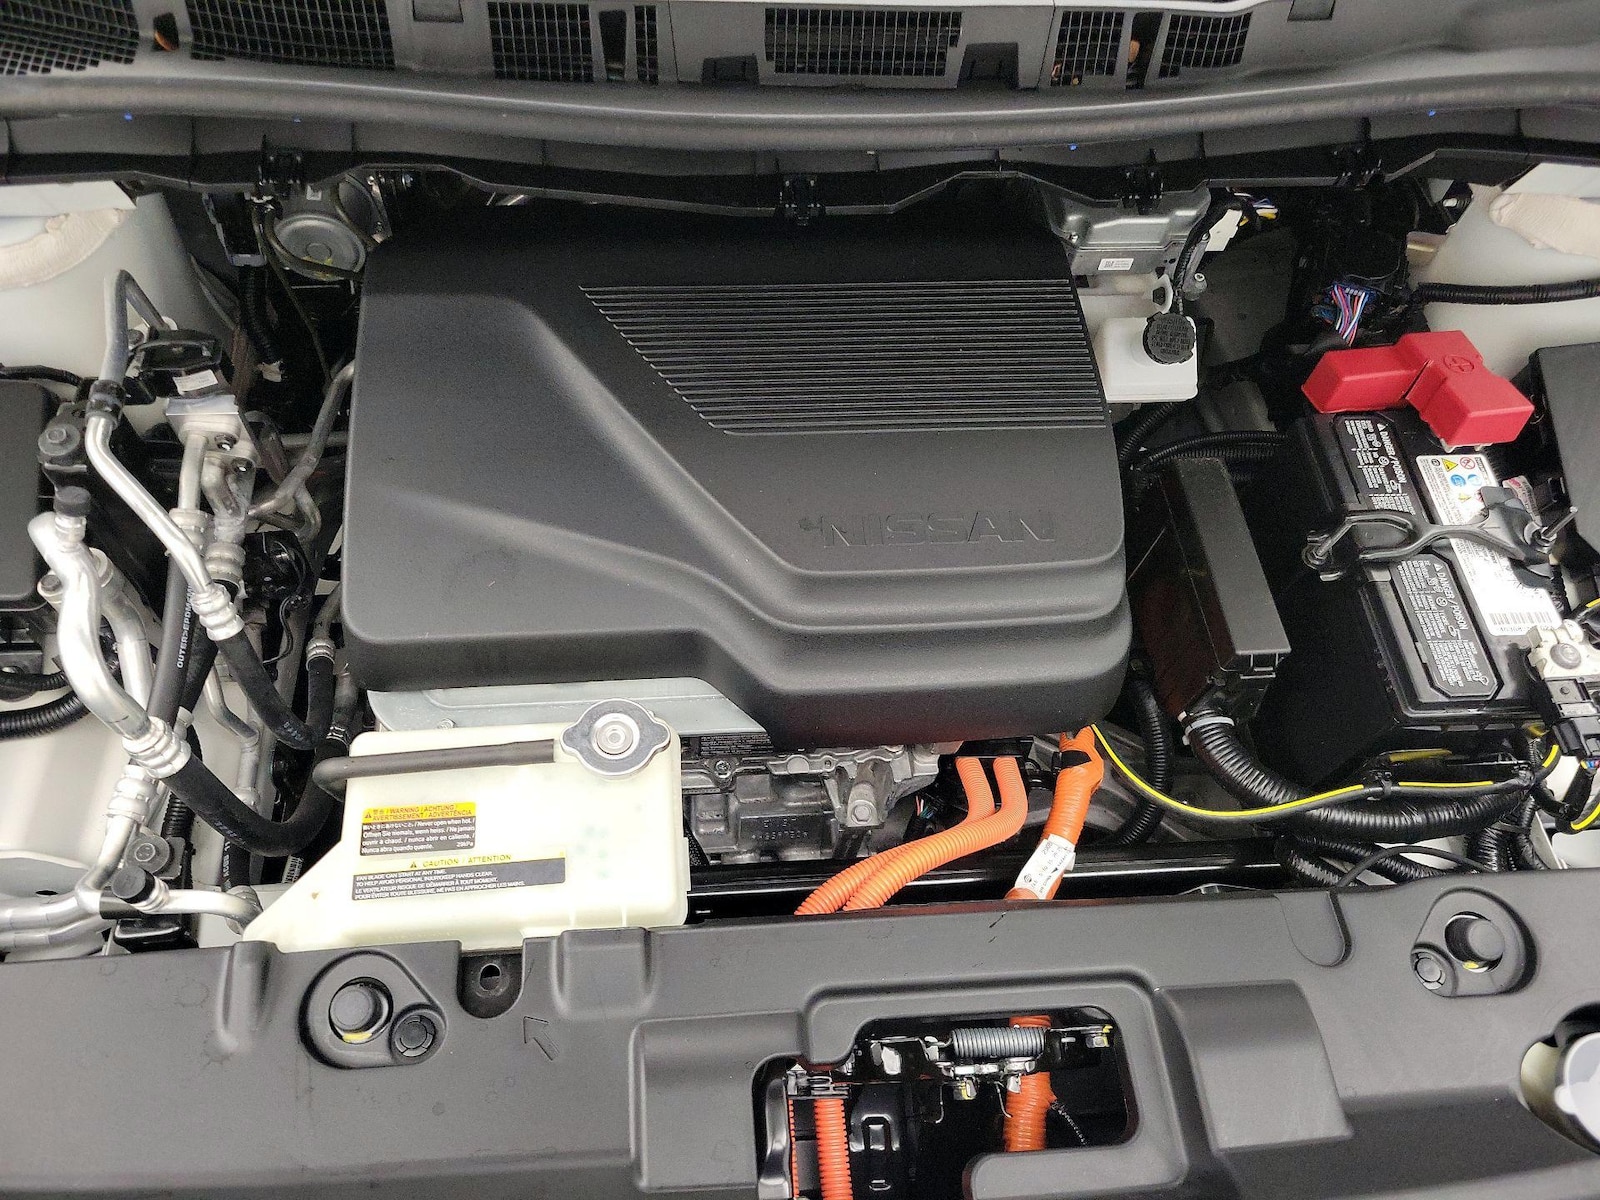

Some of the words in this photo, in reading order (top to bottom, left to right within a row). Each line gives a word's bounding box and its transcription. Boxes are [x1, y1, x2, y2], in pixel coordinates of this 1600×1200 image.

[821, 511, 1055, 548] NISSAN
[390, 806, 419, 814] WARNING
[424, 804, 454, 812] ACHTUNG
[373, 813, 423, 821] AVERTISSEMENT
[422, 857, 459, 868] CAUTION
[468, 854, 512, 863] ATTENTION
[395, 876, 424, 884] PERSONAL
